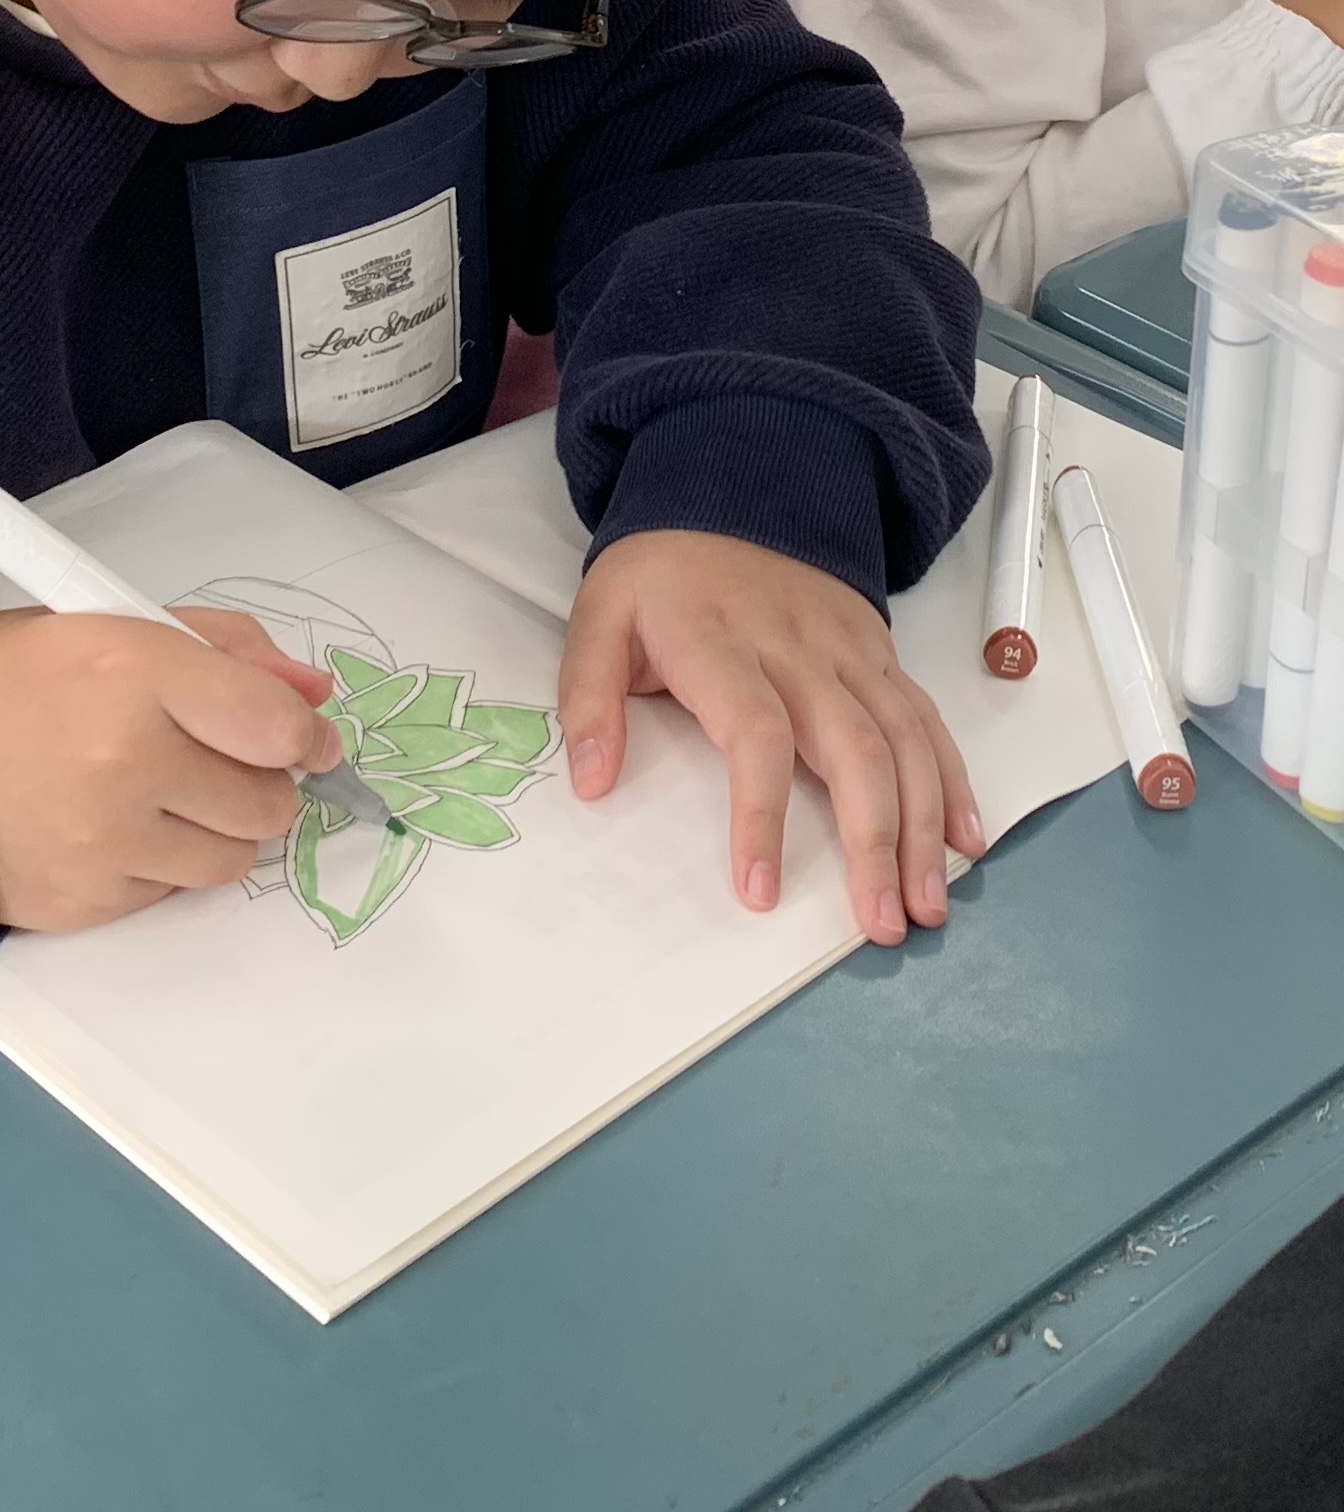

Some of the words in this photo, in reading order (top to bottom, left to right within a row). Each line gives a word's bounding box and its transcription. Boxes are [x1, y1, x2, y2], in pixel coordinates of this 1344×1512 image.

[300, 327, 369, 360] Levi
[369, 292, 448, 343] Strauss
[1004, 646, 1022, 661] 94
[1161, 777, 1181, 791] 95
